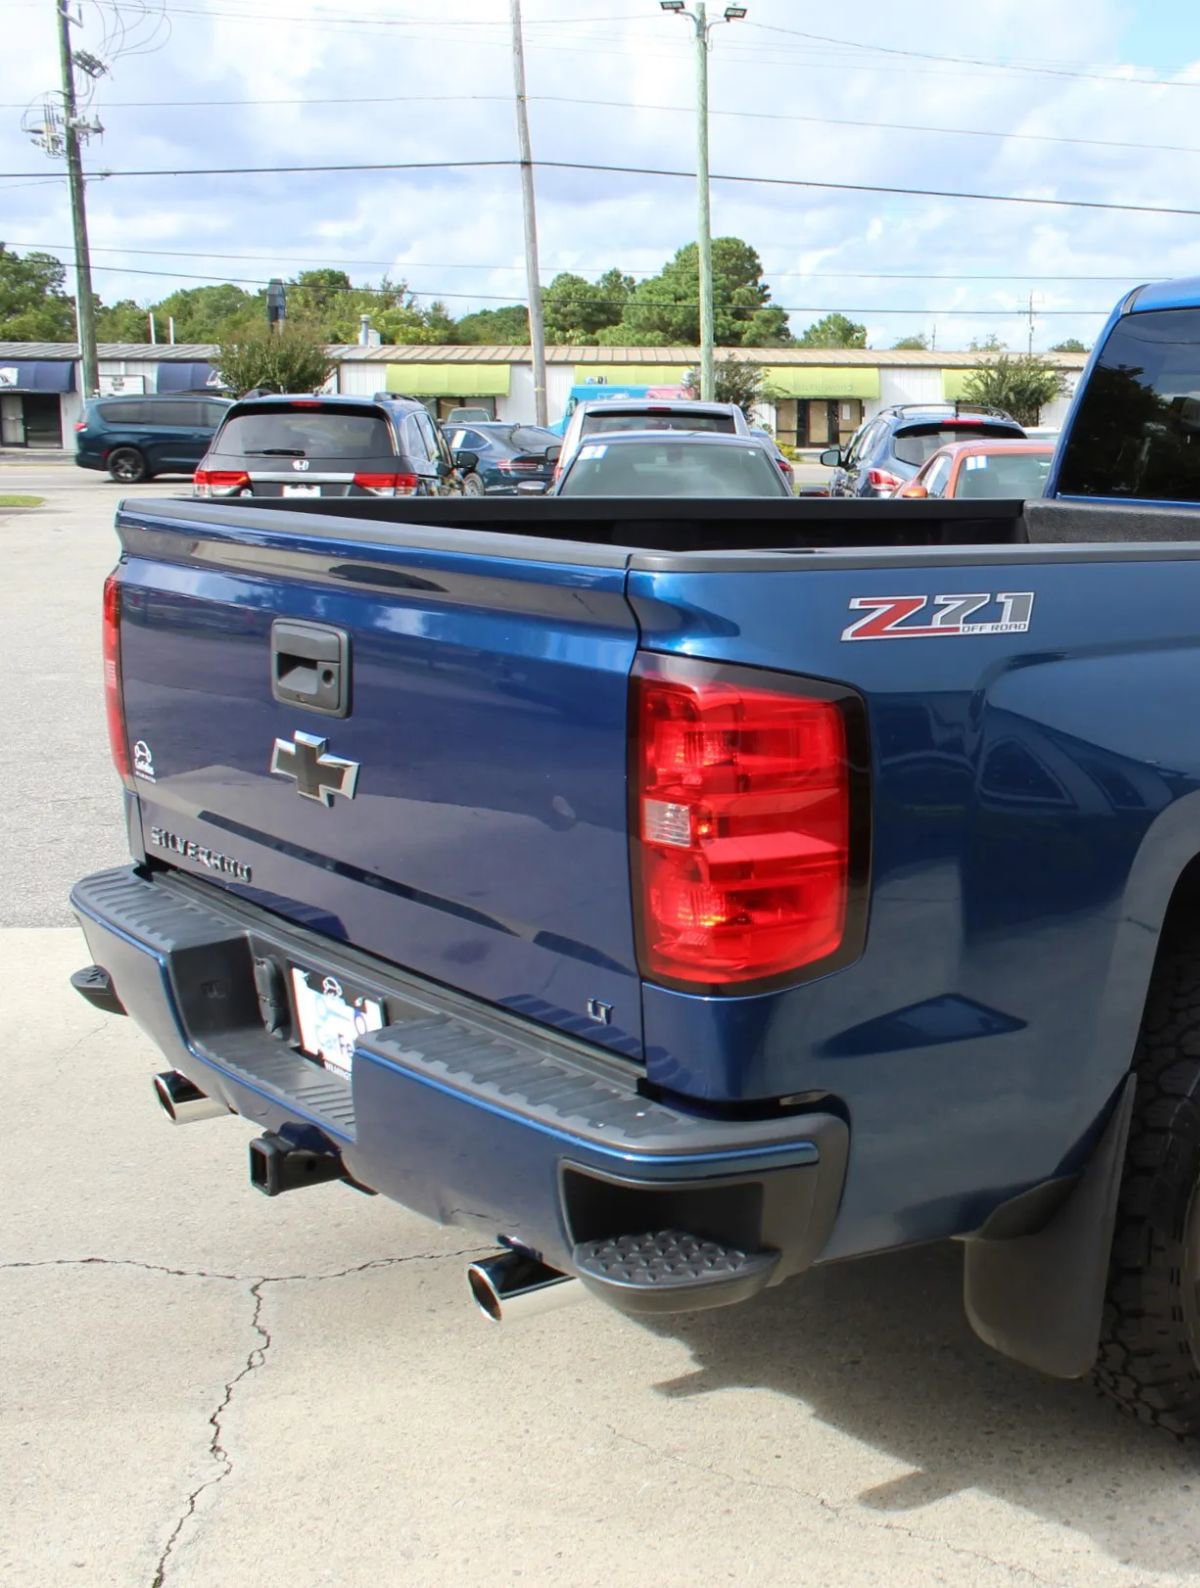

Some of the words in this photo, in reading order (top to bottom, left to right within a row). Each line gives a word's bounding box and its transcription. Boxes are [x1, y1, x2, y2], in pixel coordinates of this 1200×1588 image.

[841, 592, 1035, 641] Z71
[961, 623, 987, 633] OFF
[990, 621, 1027, 631] ROAD
[151, 826, 252, 883] SILVERADO
[587, 998, 614, 1025] LT
